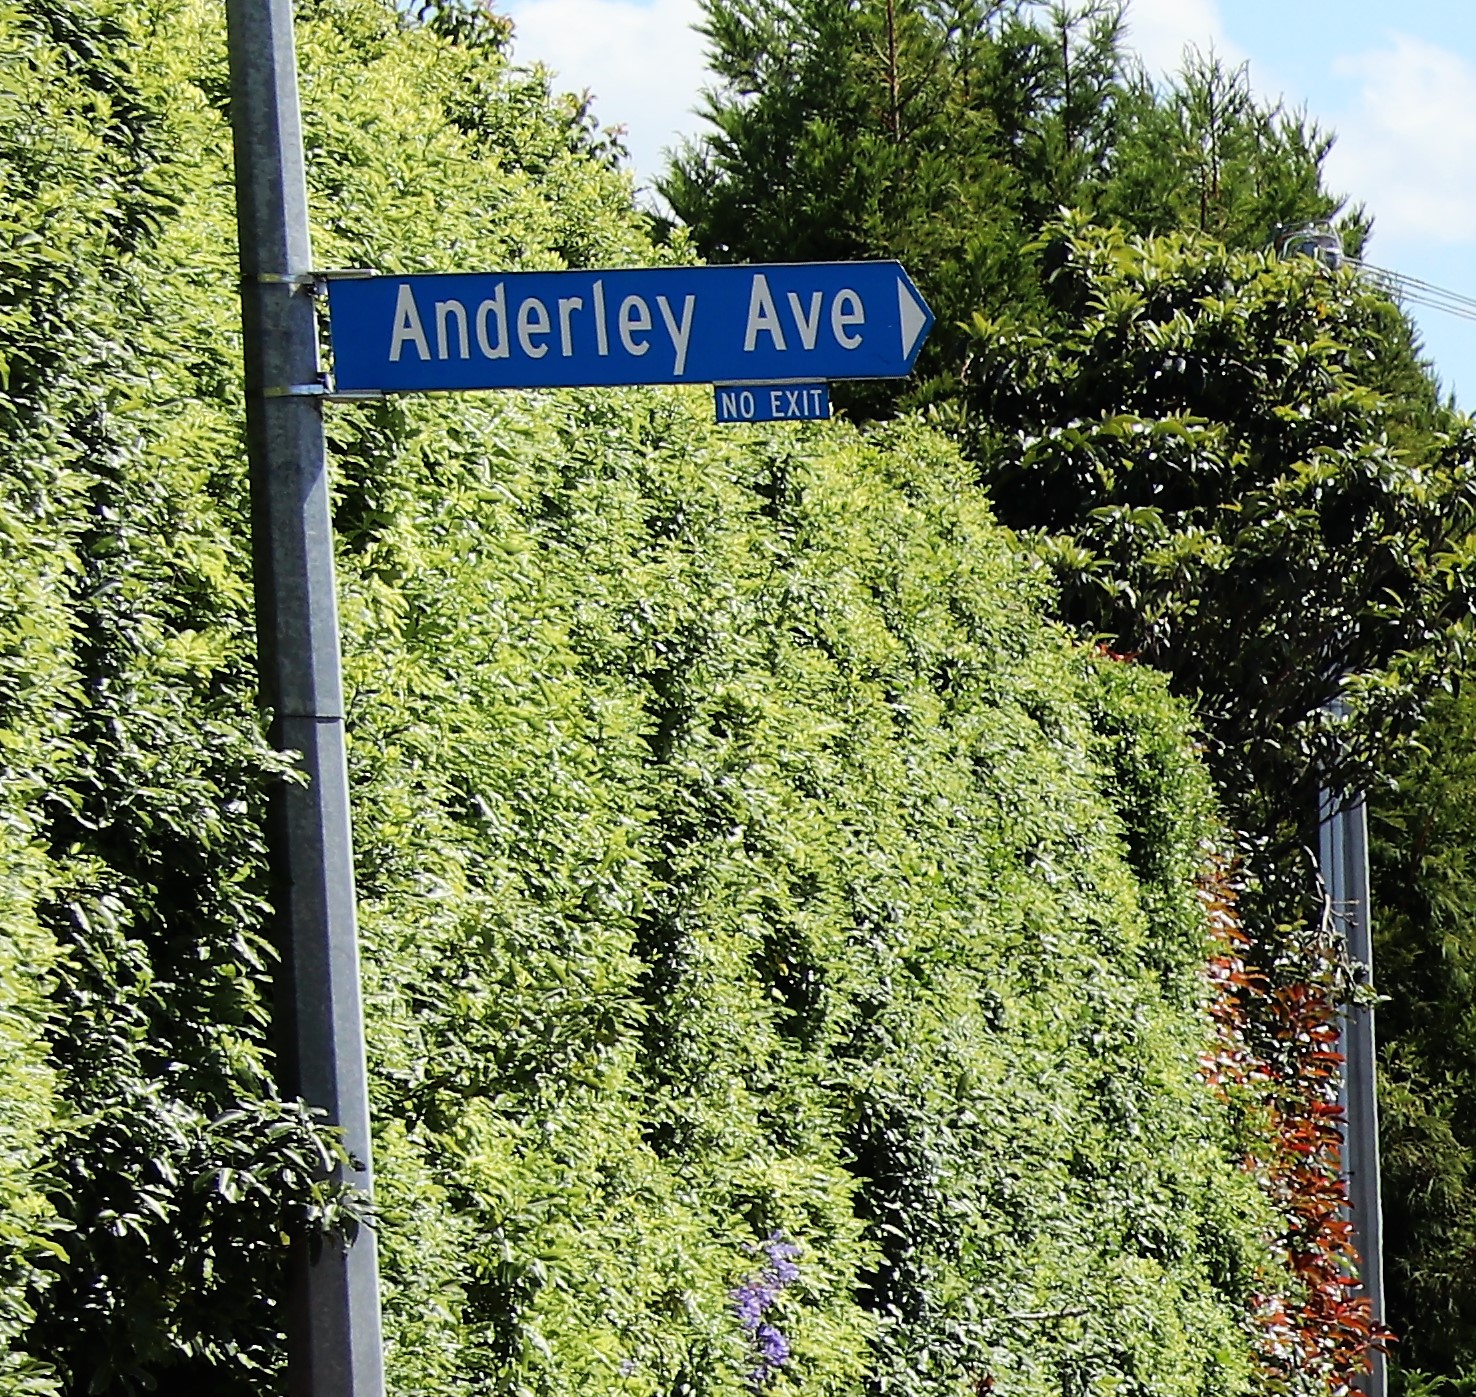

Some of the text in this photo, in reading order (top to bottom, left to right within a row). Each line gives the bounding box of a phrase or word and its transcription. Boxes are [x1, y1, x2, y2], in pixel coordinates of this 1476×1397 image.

[389, 274, 865, 376] Anderley Ave
[721, 389, 823, 419] NO EXIT
